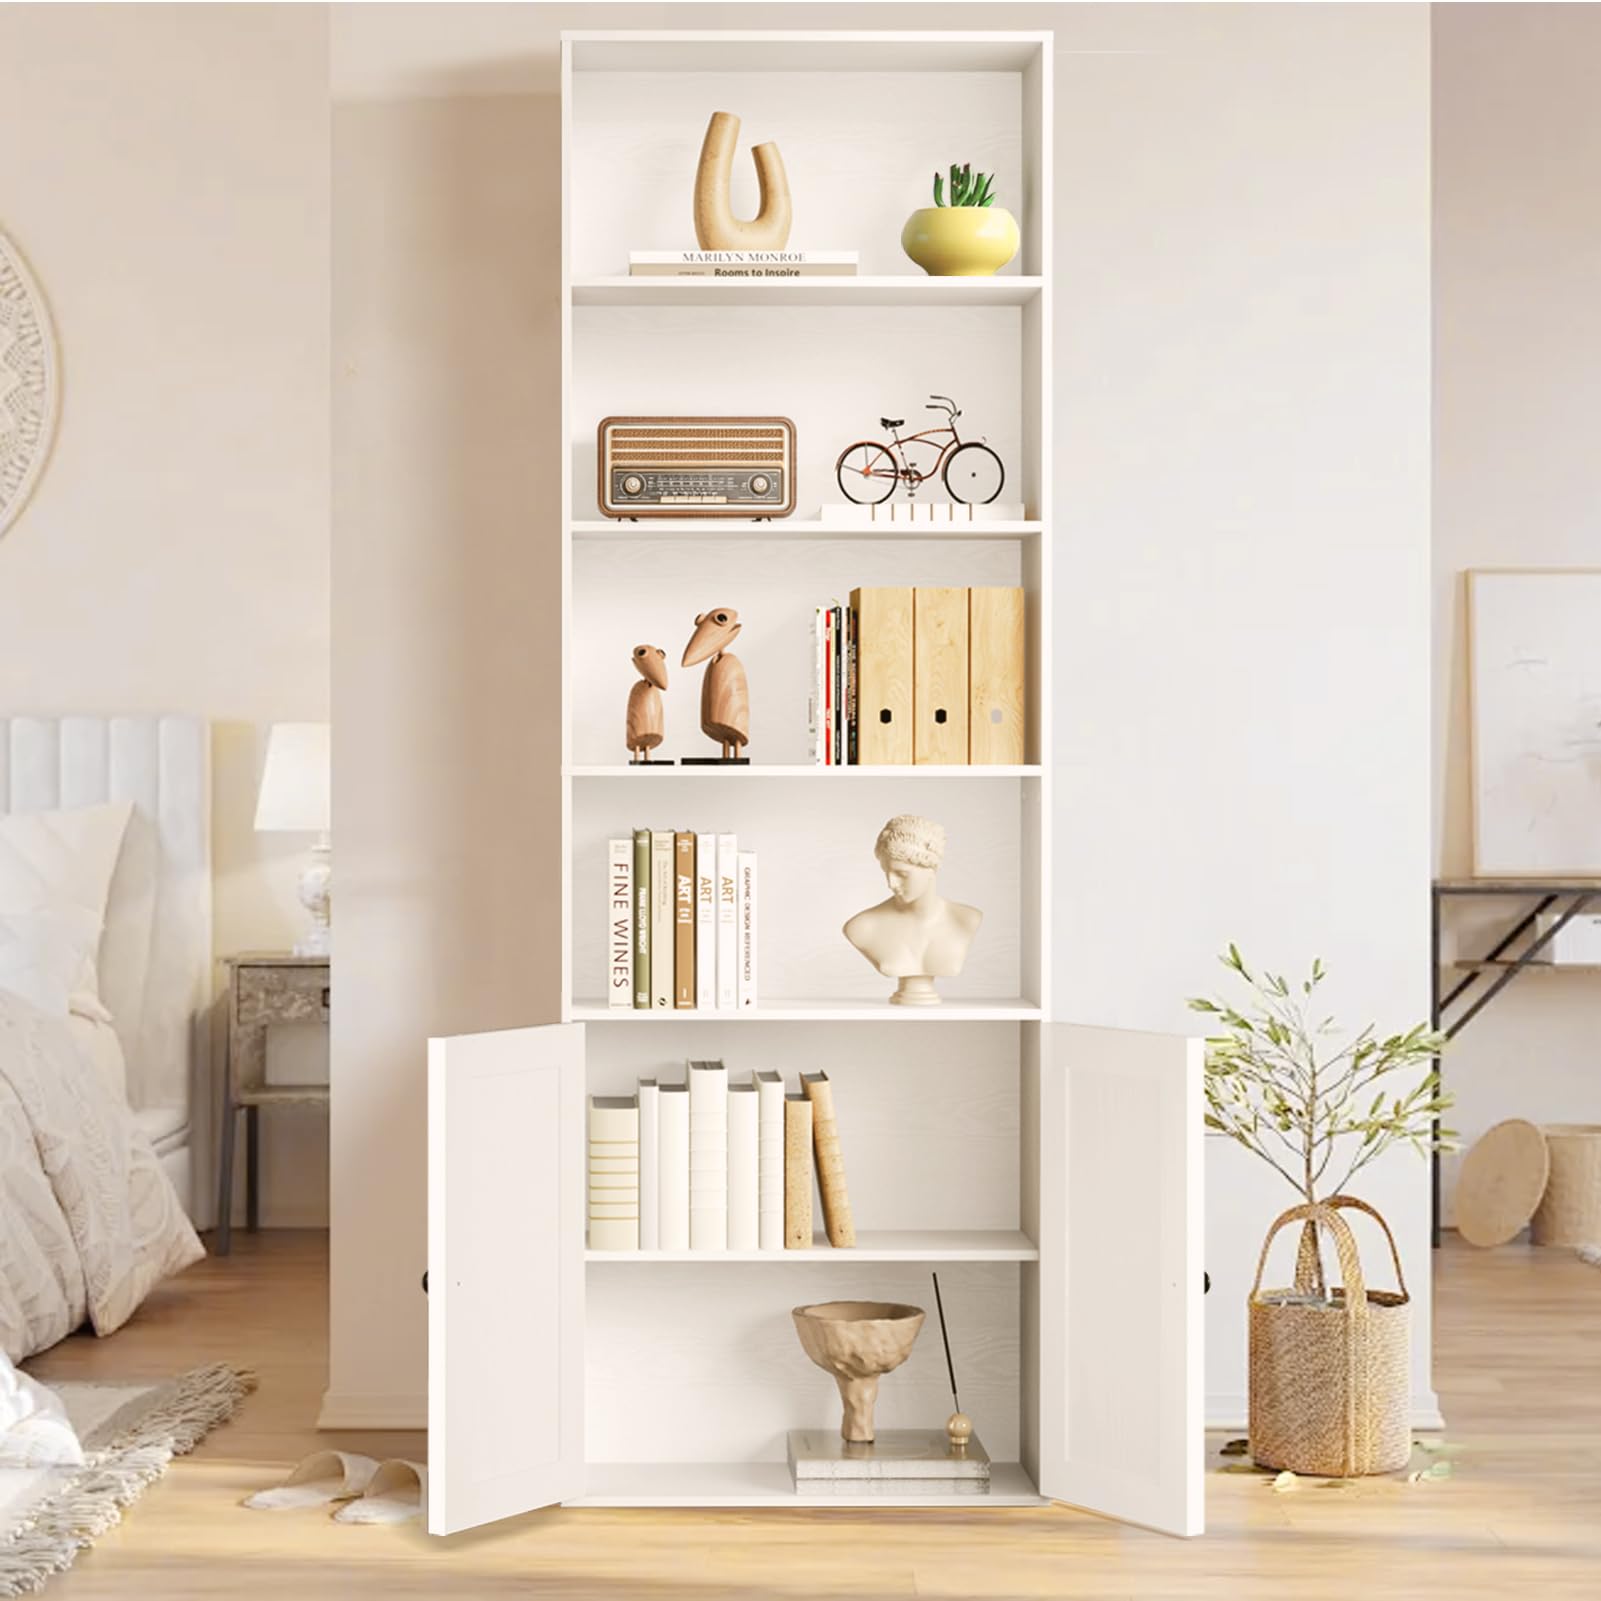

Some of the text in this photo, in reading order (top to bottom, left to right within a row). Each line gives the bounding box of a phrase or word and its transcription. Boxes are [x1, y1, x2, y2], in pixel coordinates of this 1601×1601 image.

[682, 252, 807, 262] MARILYN MONROE
[714, 268, 749, 277] Rooms
[751, 269, 763, 277] to
[613, 863, 629, 909] FINE
[677, 874, 692, 905] ART
[700, 876, 712, 904] ART
[721, 876, 734, 904] ART
[743, 867, 752, 900] GRAPHIC
[743, 902, 752, 930] DESIGN
[613, 918, 629, 988] WINES
